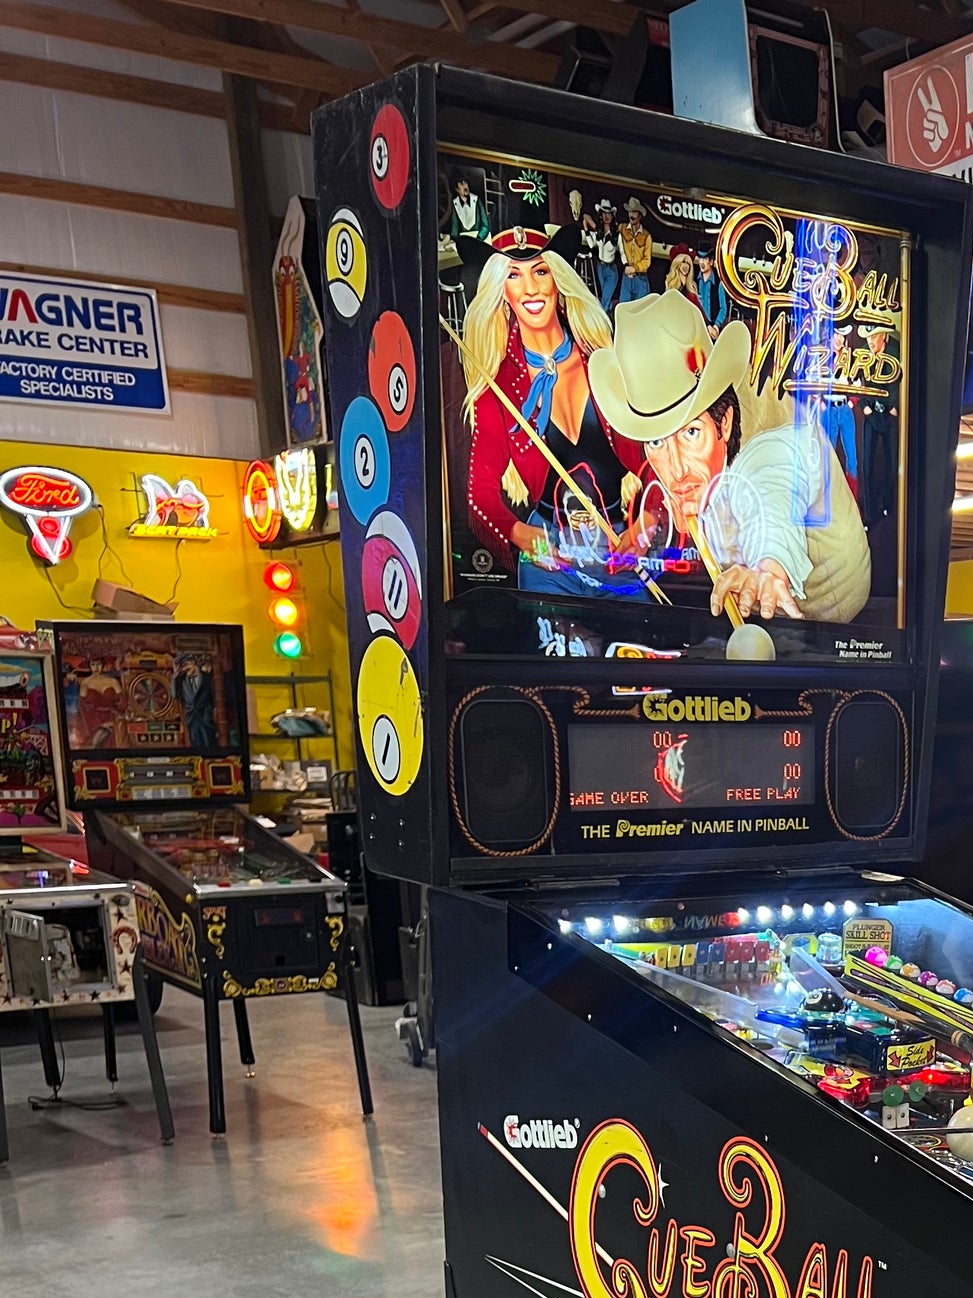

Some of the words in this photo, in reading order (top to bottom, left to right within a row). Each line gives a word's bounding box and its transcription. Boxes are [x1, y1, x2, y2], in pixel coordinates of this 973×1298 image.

[376, 145, 382, 169] 3
[657, 195, 725, 225] Gottlieb
[341, 241, 347, 264] 9
[57, 332, 149, 359] CENTER
[61, 366, 136, 386] CERTIFIED
[20, 379, 114, 400] SPECIALISTS
[361, 446, 370, 477] 2
[10, 472, 80, 505] Ford
[835, 640, 848, 649] The
[849, 639, 884, 650] Premier
[839, 650, 858, 658] Name
[860, 650, 867, 658] in
[867, 650, 892, 659] Pinball
[642, 692, 751, 722] Gottlieb
[653, 731, 672, 748] 00
[783, 730, 801, 747] 00
[783, 763, 801, 780] 00
[610, 790, 649, 804] OVER
[726, 788, 762, 801] FREE
[766, 786, 801, 800] PLAY
[580, 824, 611, 839] THE
[615, 819, 684, 838] Premier
[691, 820, 734, 834] NAME
[737, 819, 752, 832] IN
[754, 817, 810, 832] PINBALL
[870, 931, 891, 940] SHOT
[907, 1045, 924, 1057] Side
[504, 1115, 577, 1149] Gottlieb
